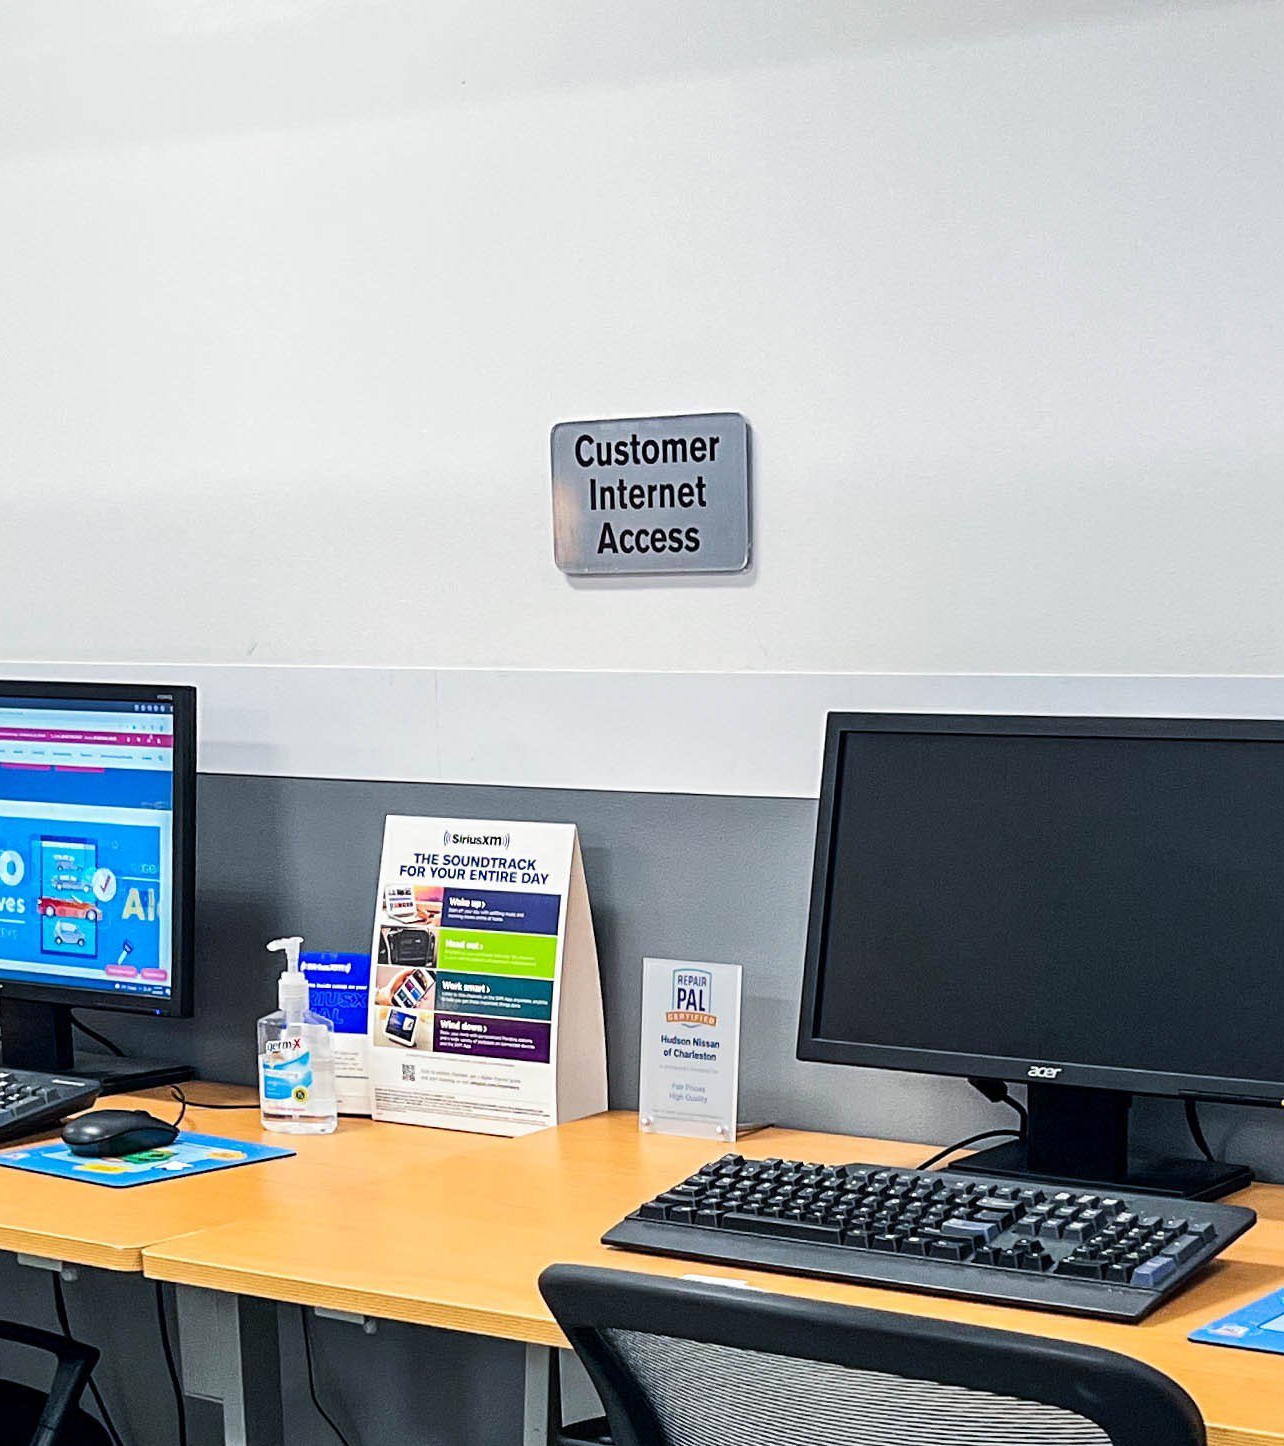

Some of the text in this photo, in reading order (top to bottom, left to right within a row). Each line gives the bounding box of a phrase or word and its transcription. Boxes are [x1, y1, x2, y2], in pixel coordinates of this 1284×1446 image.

[574, 434, 720, 468] Customer
[589, 475, 707, 511] Internet
[597, 522, 700, 554] Access
[413, 852, 537, 871] THE SOUNDTRACK
[399, 865, 549, 885] FOR YOUR ENTIRE DAY
[677, 974, 707, 987] REPAIR
[677, 987, 706, 1012] PAL
[667, 1012, 716, 1025] CERTIFIED
[266, 1038, 301, 1052] germ-X
[660, 1034, 720, 1049] Hudson Nissan
[663, 1048, 717, 1062] of Charleston
[1027, 1065, 1062, 1079] acer
